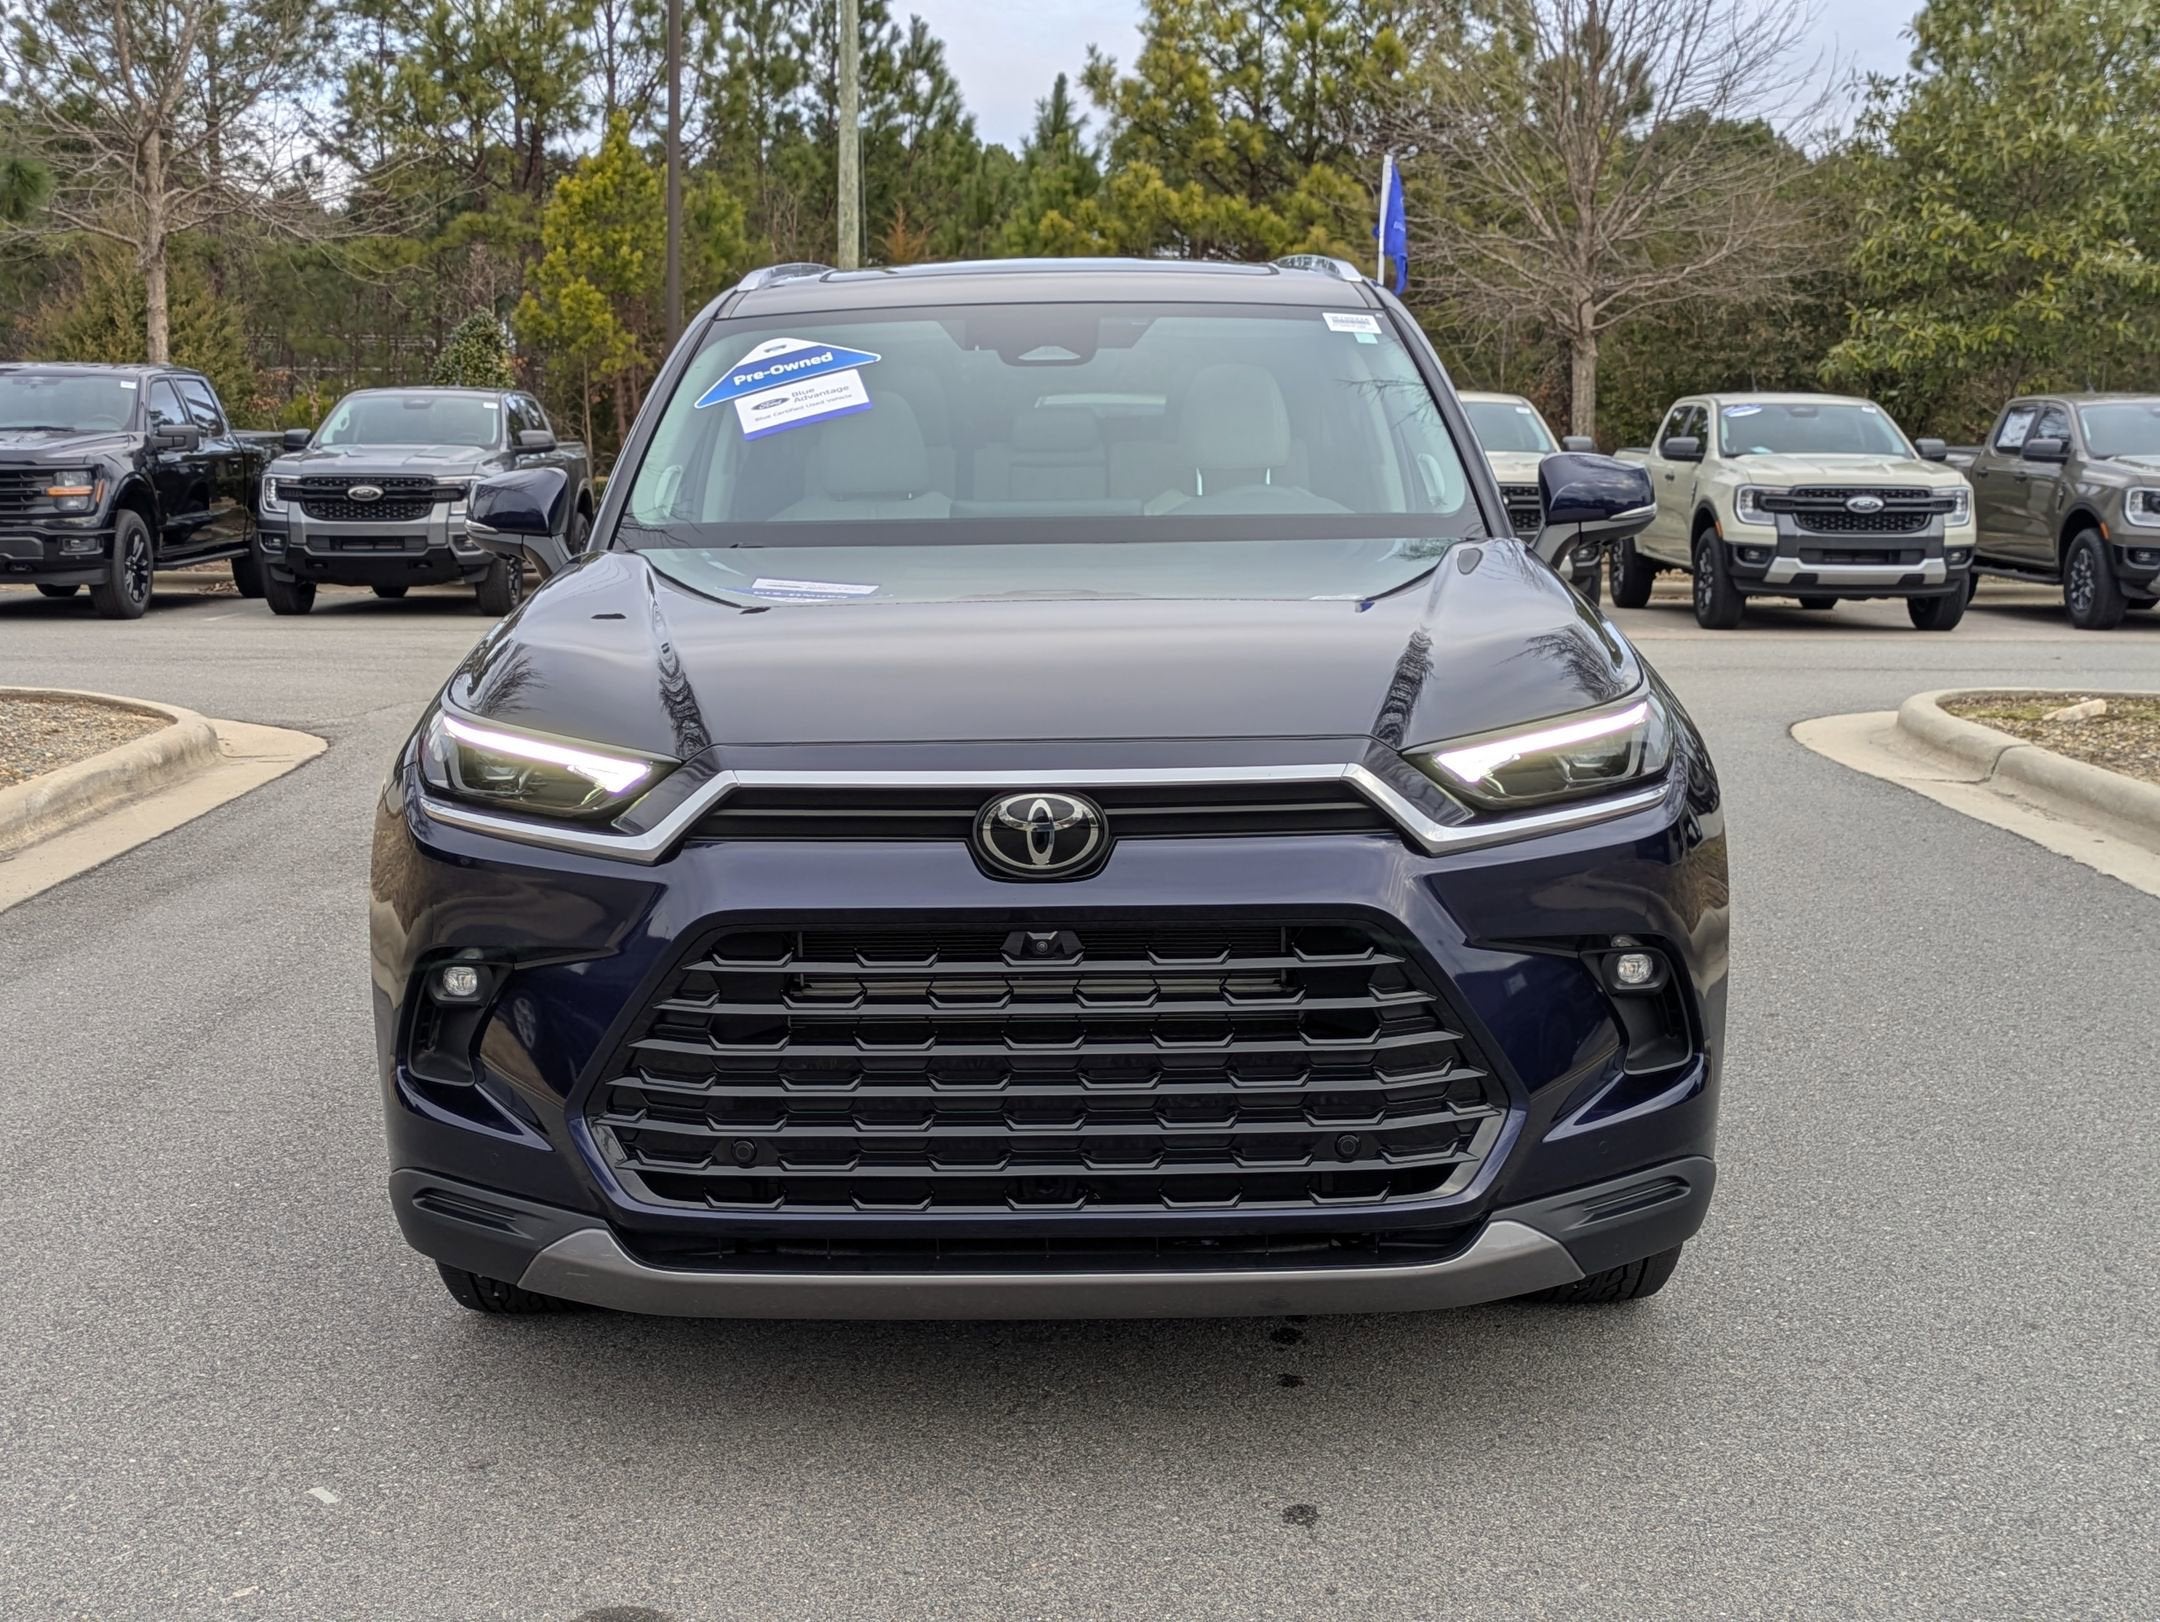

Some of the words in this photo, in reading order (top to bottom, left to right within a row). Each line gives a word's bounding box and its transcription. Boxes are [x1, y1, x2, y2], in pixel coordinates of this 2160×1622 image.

[733, 352, 833, 386] Pre-Owned
[791, 388, 815, 398] Blue
[794, 386, 850, 403] Advantage
